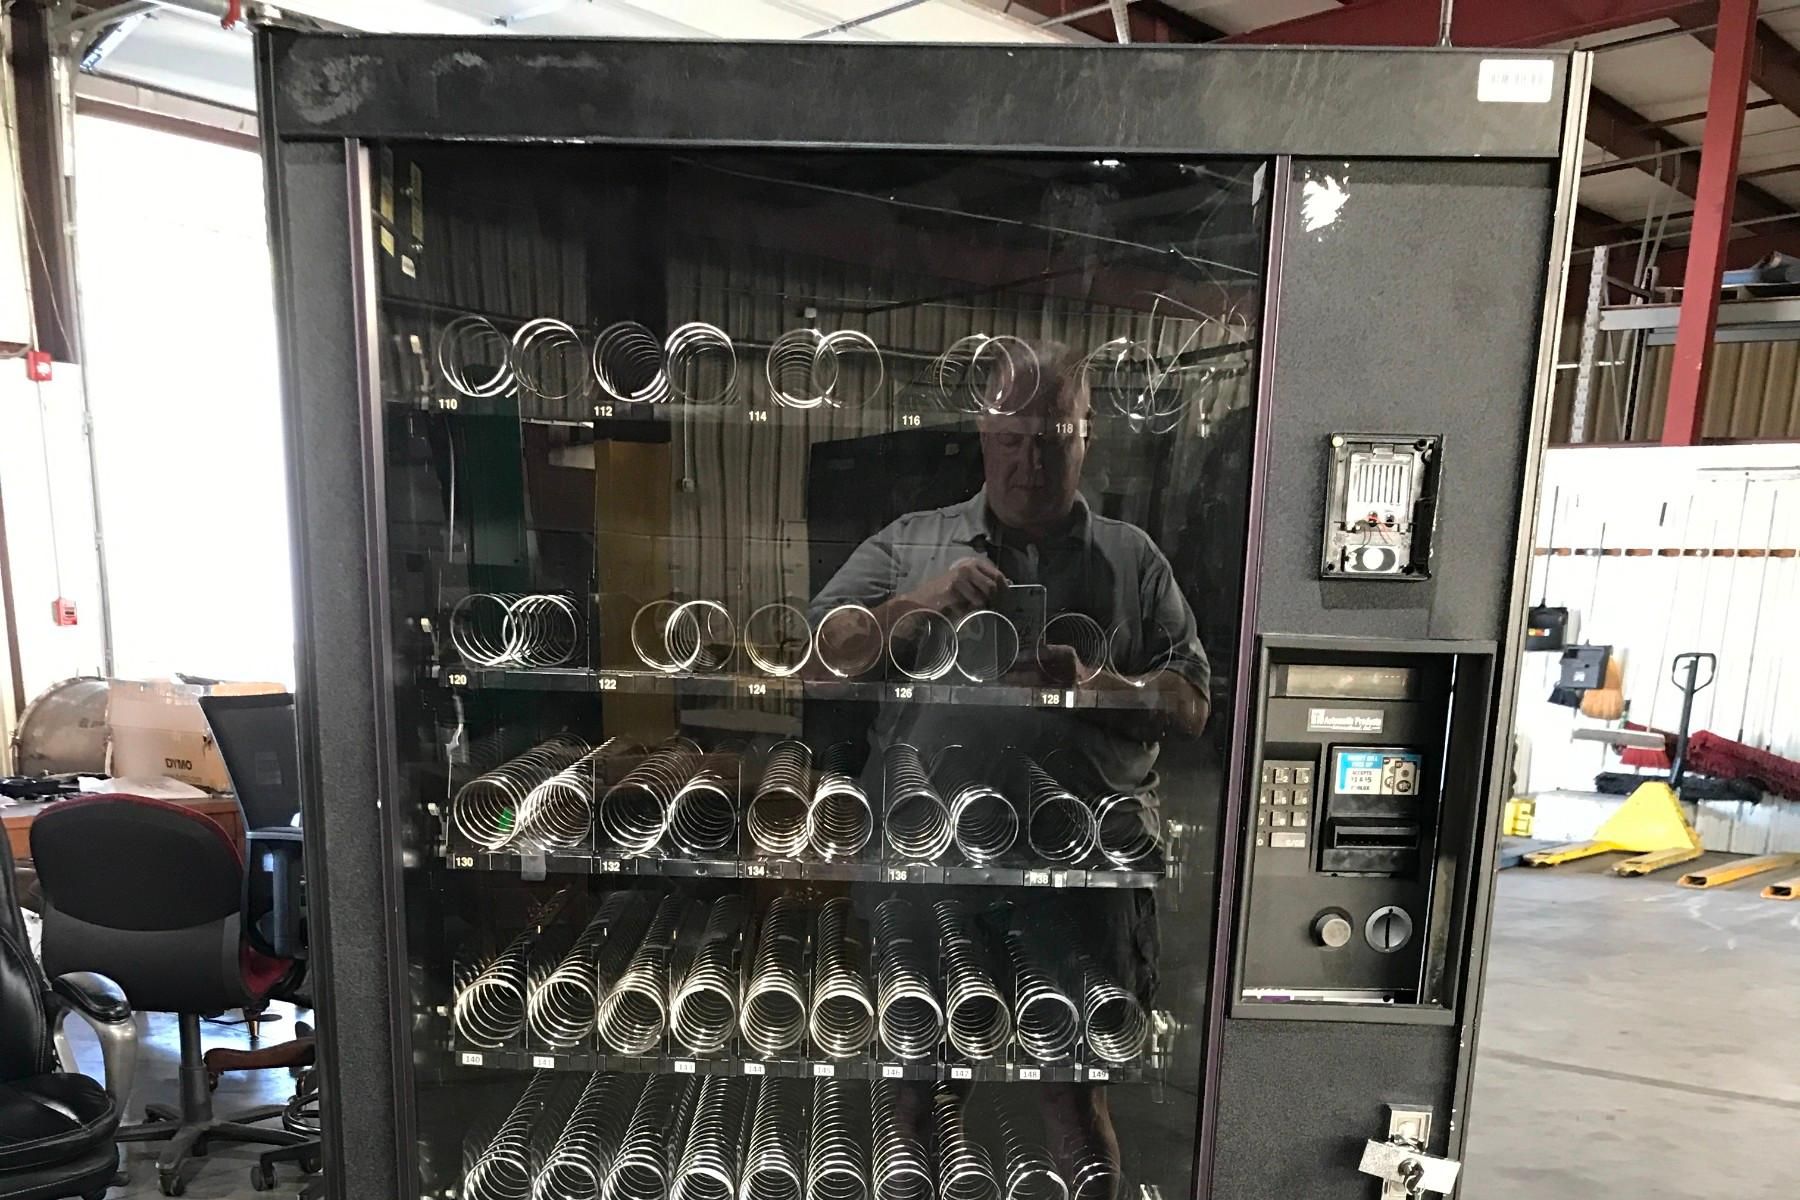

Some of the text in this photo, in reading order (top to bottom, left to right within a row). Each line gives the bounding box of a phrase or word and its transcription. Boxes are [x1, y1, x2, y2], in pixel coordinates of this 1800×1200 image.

[438, 398, 458, 410] 110
[594, 405, 613, 417] 112
[749, 410, 767, 422] 114
[902, 415, 921, 426] 116
[1056, 423, 1074, 434] 118
[448, 674, 467, 685] 120
[598, 678, 617, 690] 122
[748, 683, 767, 695] 124
[895, 687, 913, 699] 126
[1042, 693, 1060, 705] 128
[165, 758, 193, 771] DYMO
[455, 856, 474, 868] 130
[602, 860, 621, 872] 132
[747, 865, 765, 876] 134
[890, 869, 908, 881] 136
